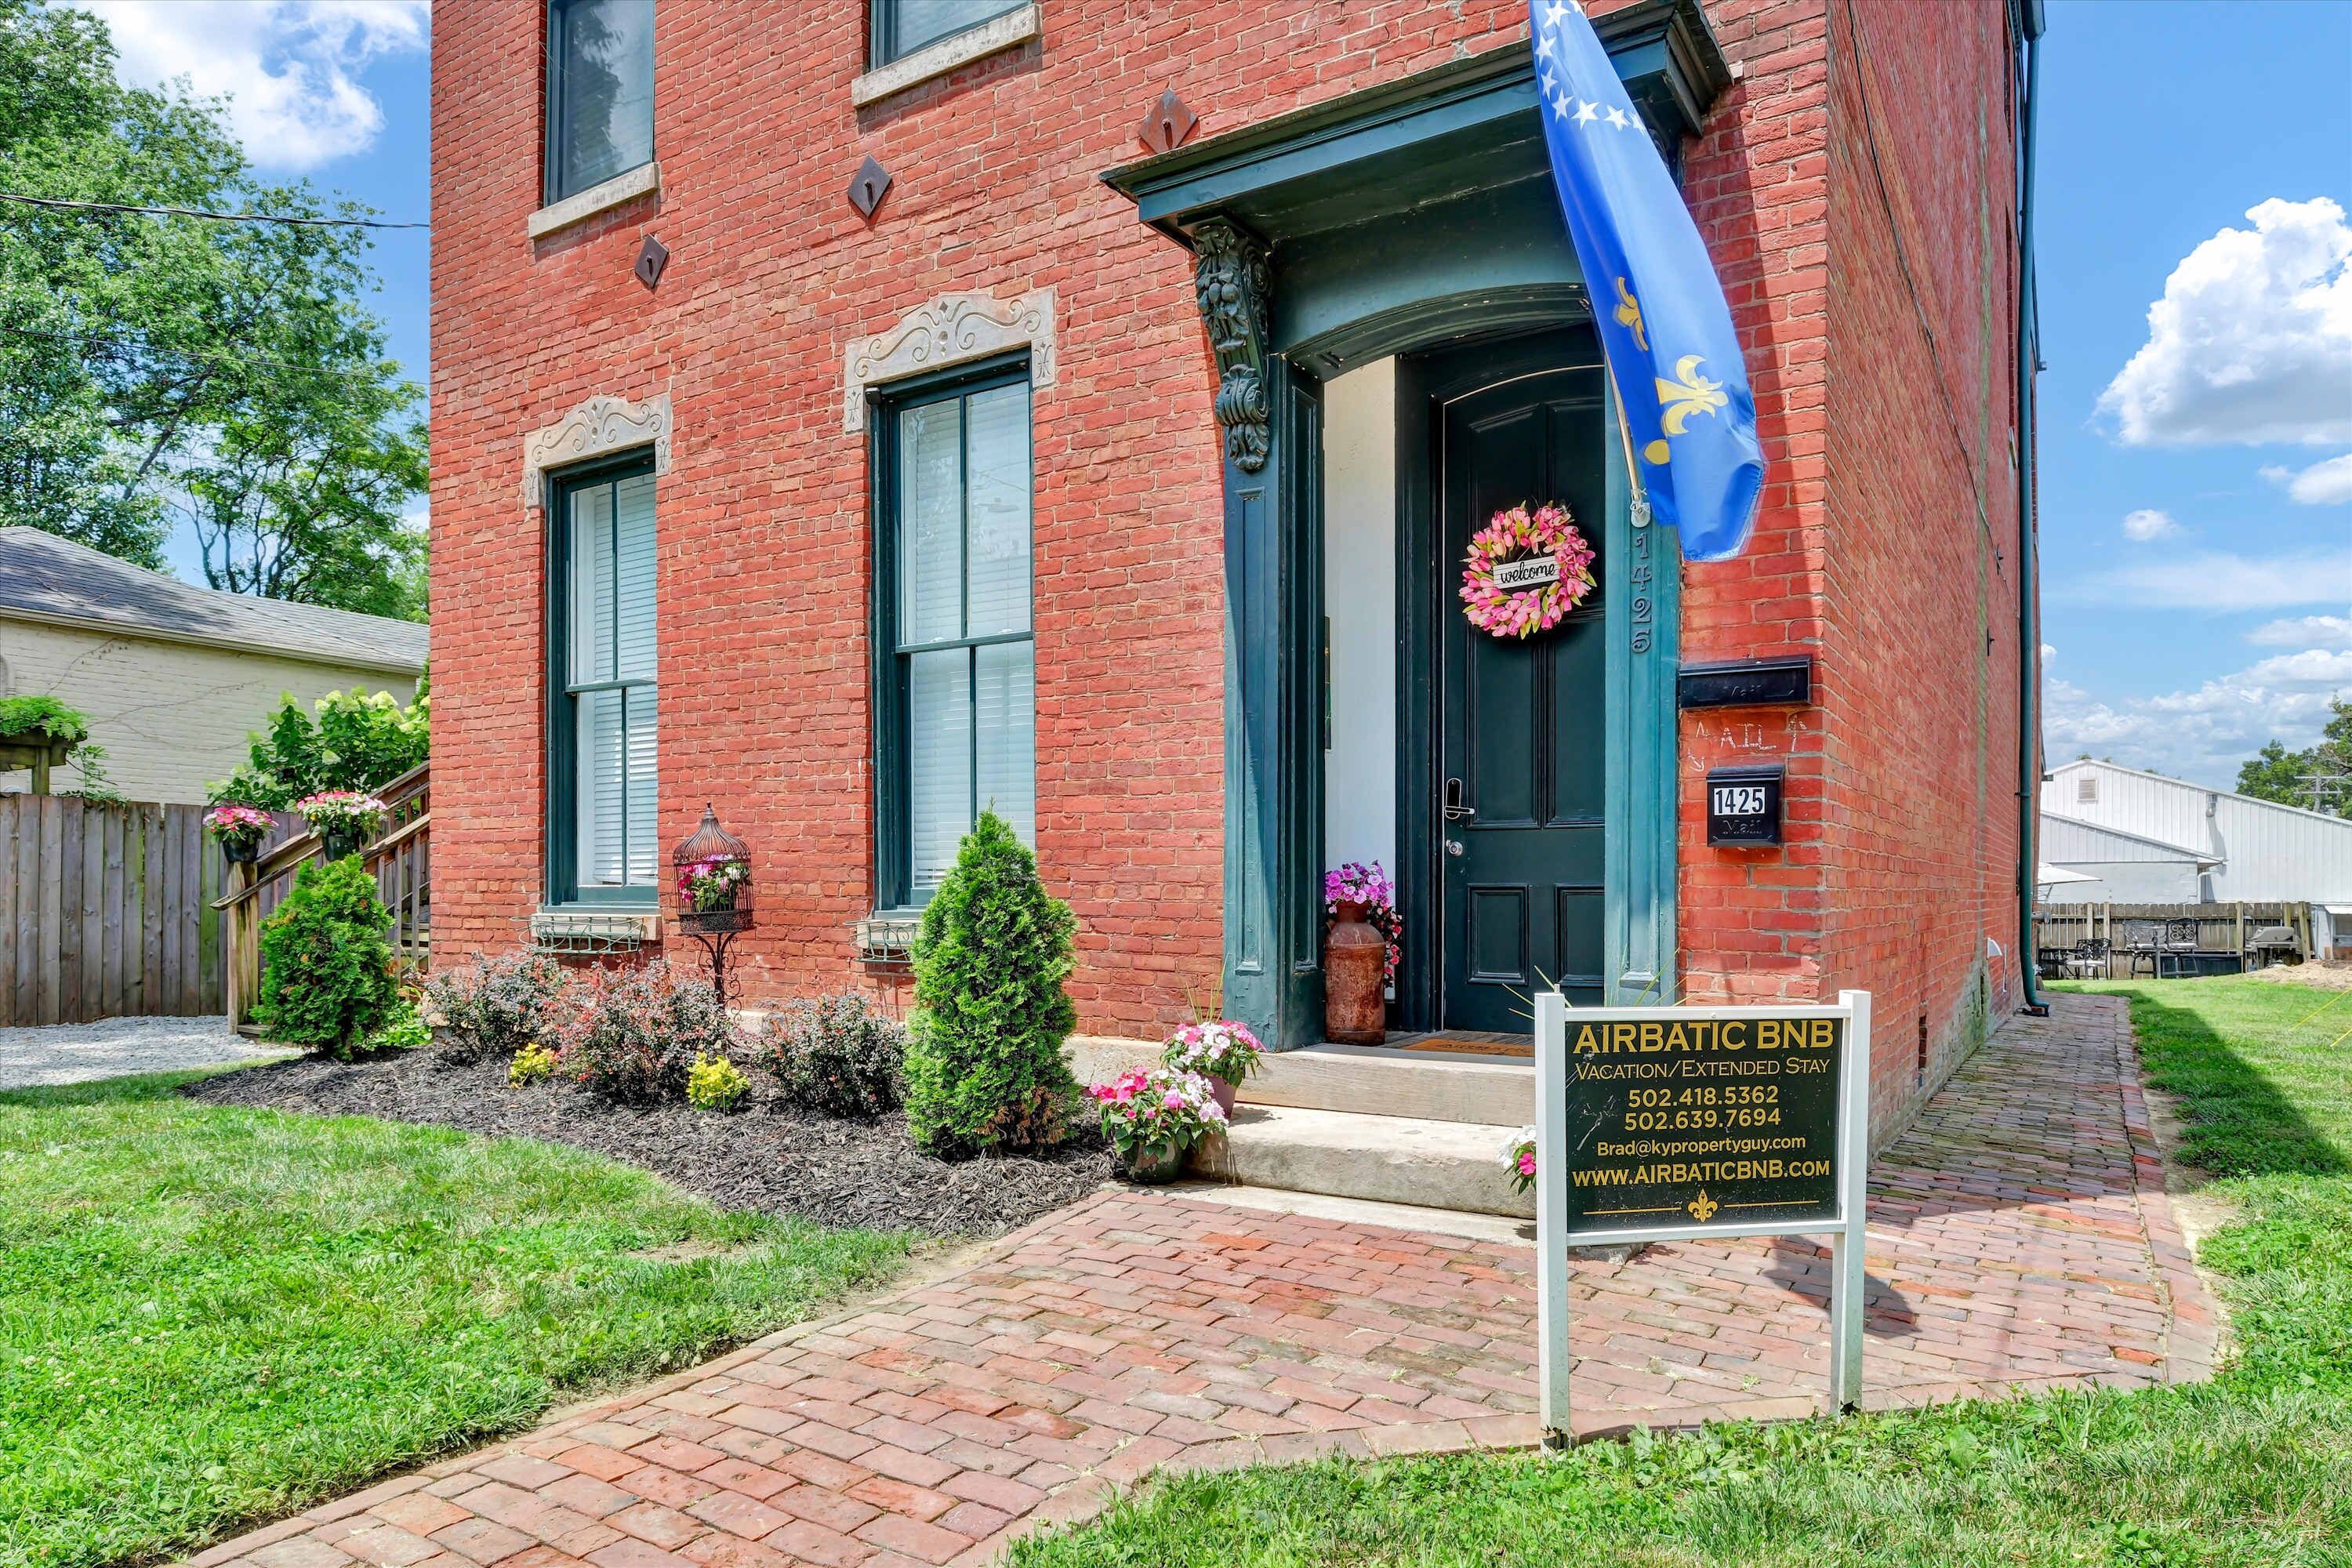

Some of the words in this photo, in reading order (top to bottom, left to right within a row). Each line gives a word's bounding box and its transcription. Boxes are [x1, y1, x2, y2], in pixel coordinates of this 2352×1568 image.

[1500, 561, 1556, 583] welcome
[1630, 532, 1652, 654] 1425
[1715, 788, 1763, 815] 1425
[1573, 1021, 1748, 1054] AIRBATIC
[1756, 1019, 1834, 1050] BNB
[1628, 1085, 1779, 1108] 502.418.5362
[1624, 1108, 1781, 1131] 502.639.7694
[1597, 1136, 1806, 1157] Brad@kypropertyguy.com
